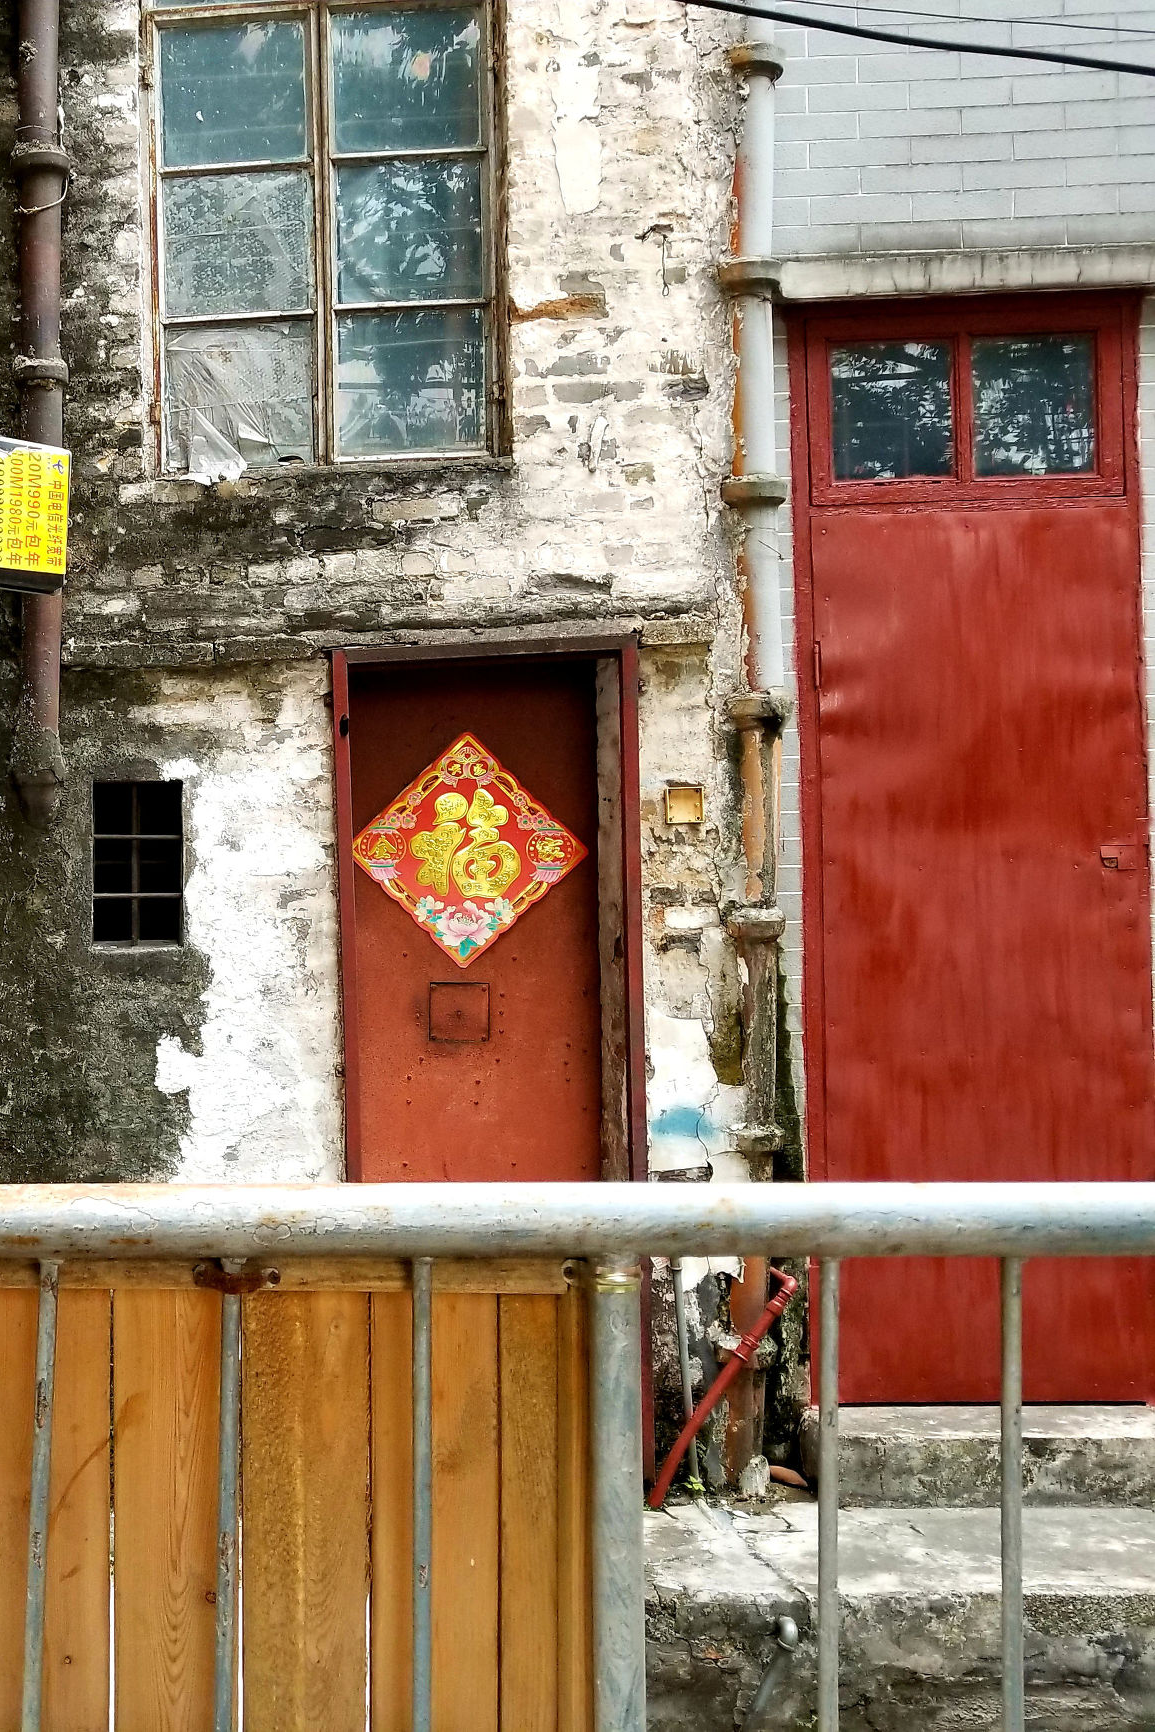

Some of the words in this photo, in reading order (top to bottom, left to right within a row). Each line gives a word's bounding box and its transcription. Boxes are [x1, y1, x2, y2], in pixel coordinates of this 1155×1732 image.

[24, 451, 42, 567] 20M990元包年
[46, 480, 65, 567] 中国电信光纤宽带
[410, 788, 522, 899] 福
